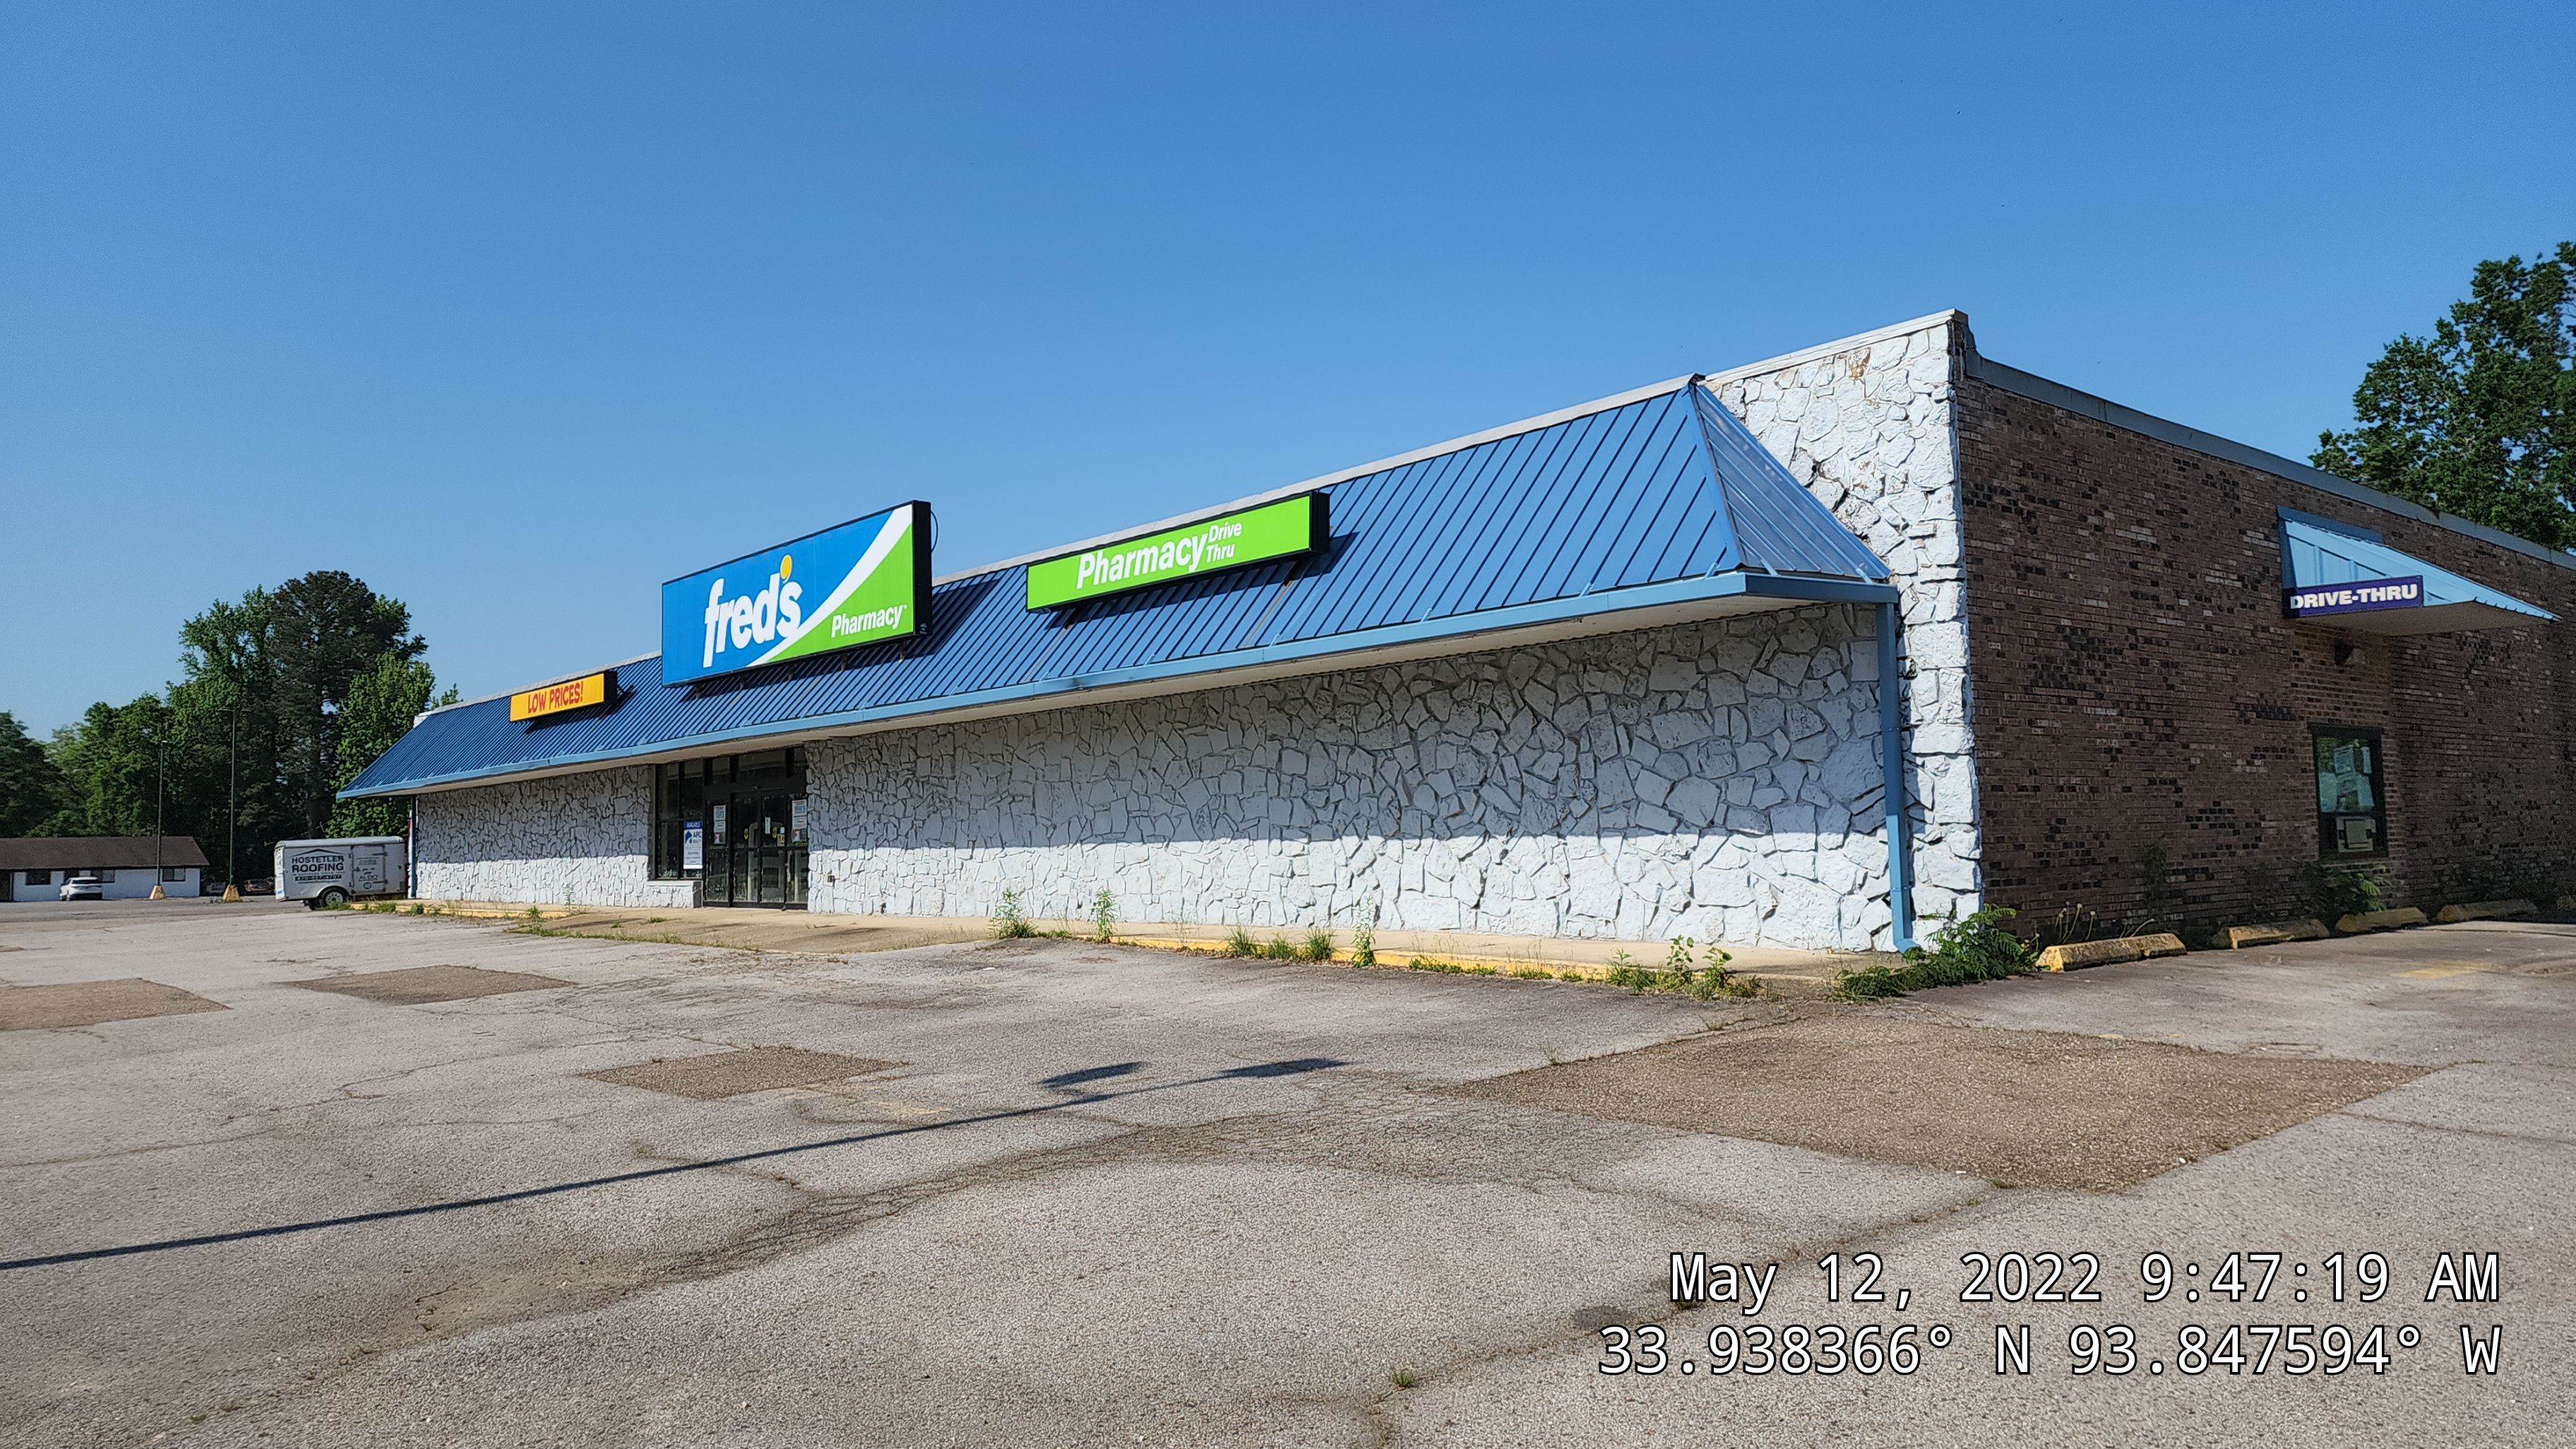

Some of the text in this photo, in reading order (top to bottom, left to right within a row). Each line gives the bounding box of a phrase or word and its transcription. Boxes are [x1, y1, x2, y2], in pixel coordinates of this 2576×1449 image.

[1208, 522, 1243, 543] Drive
[1076, 533, 1208, 590] Pharmacy
[1206, 544, 1235, 563] Thru
[2290, 583, 2418, 609] DRIVE-THRU
[831, 604, 904, 638] Pharmacy
[527, 681, 583, 714] LOW PRICES!
[292, 855, 345, 864] HOSTETLER
[292, 862, 344, 873] ROOFING
